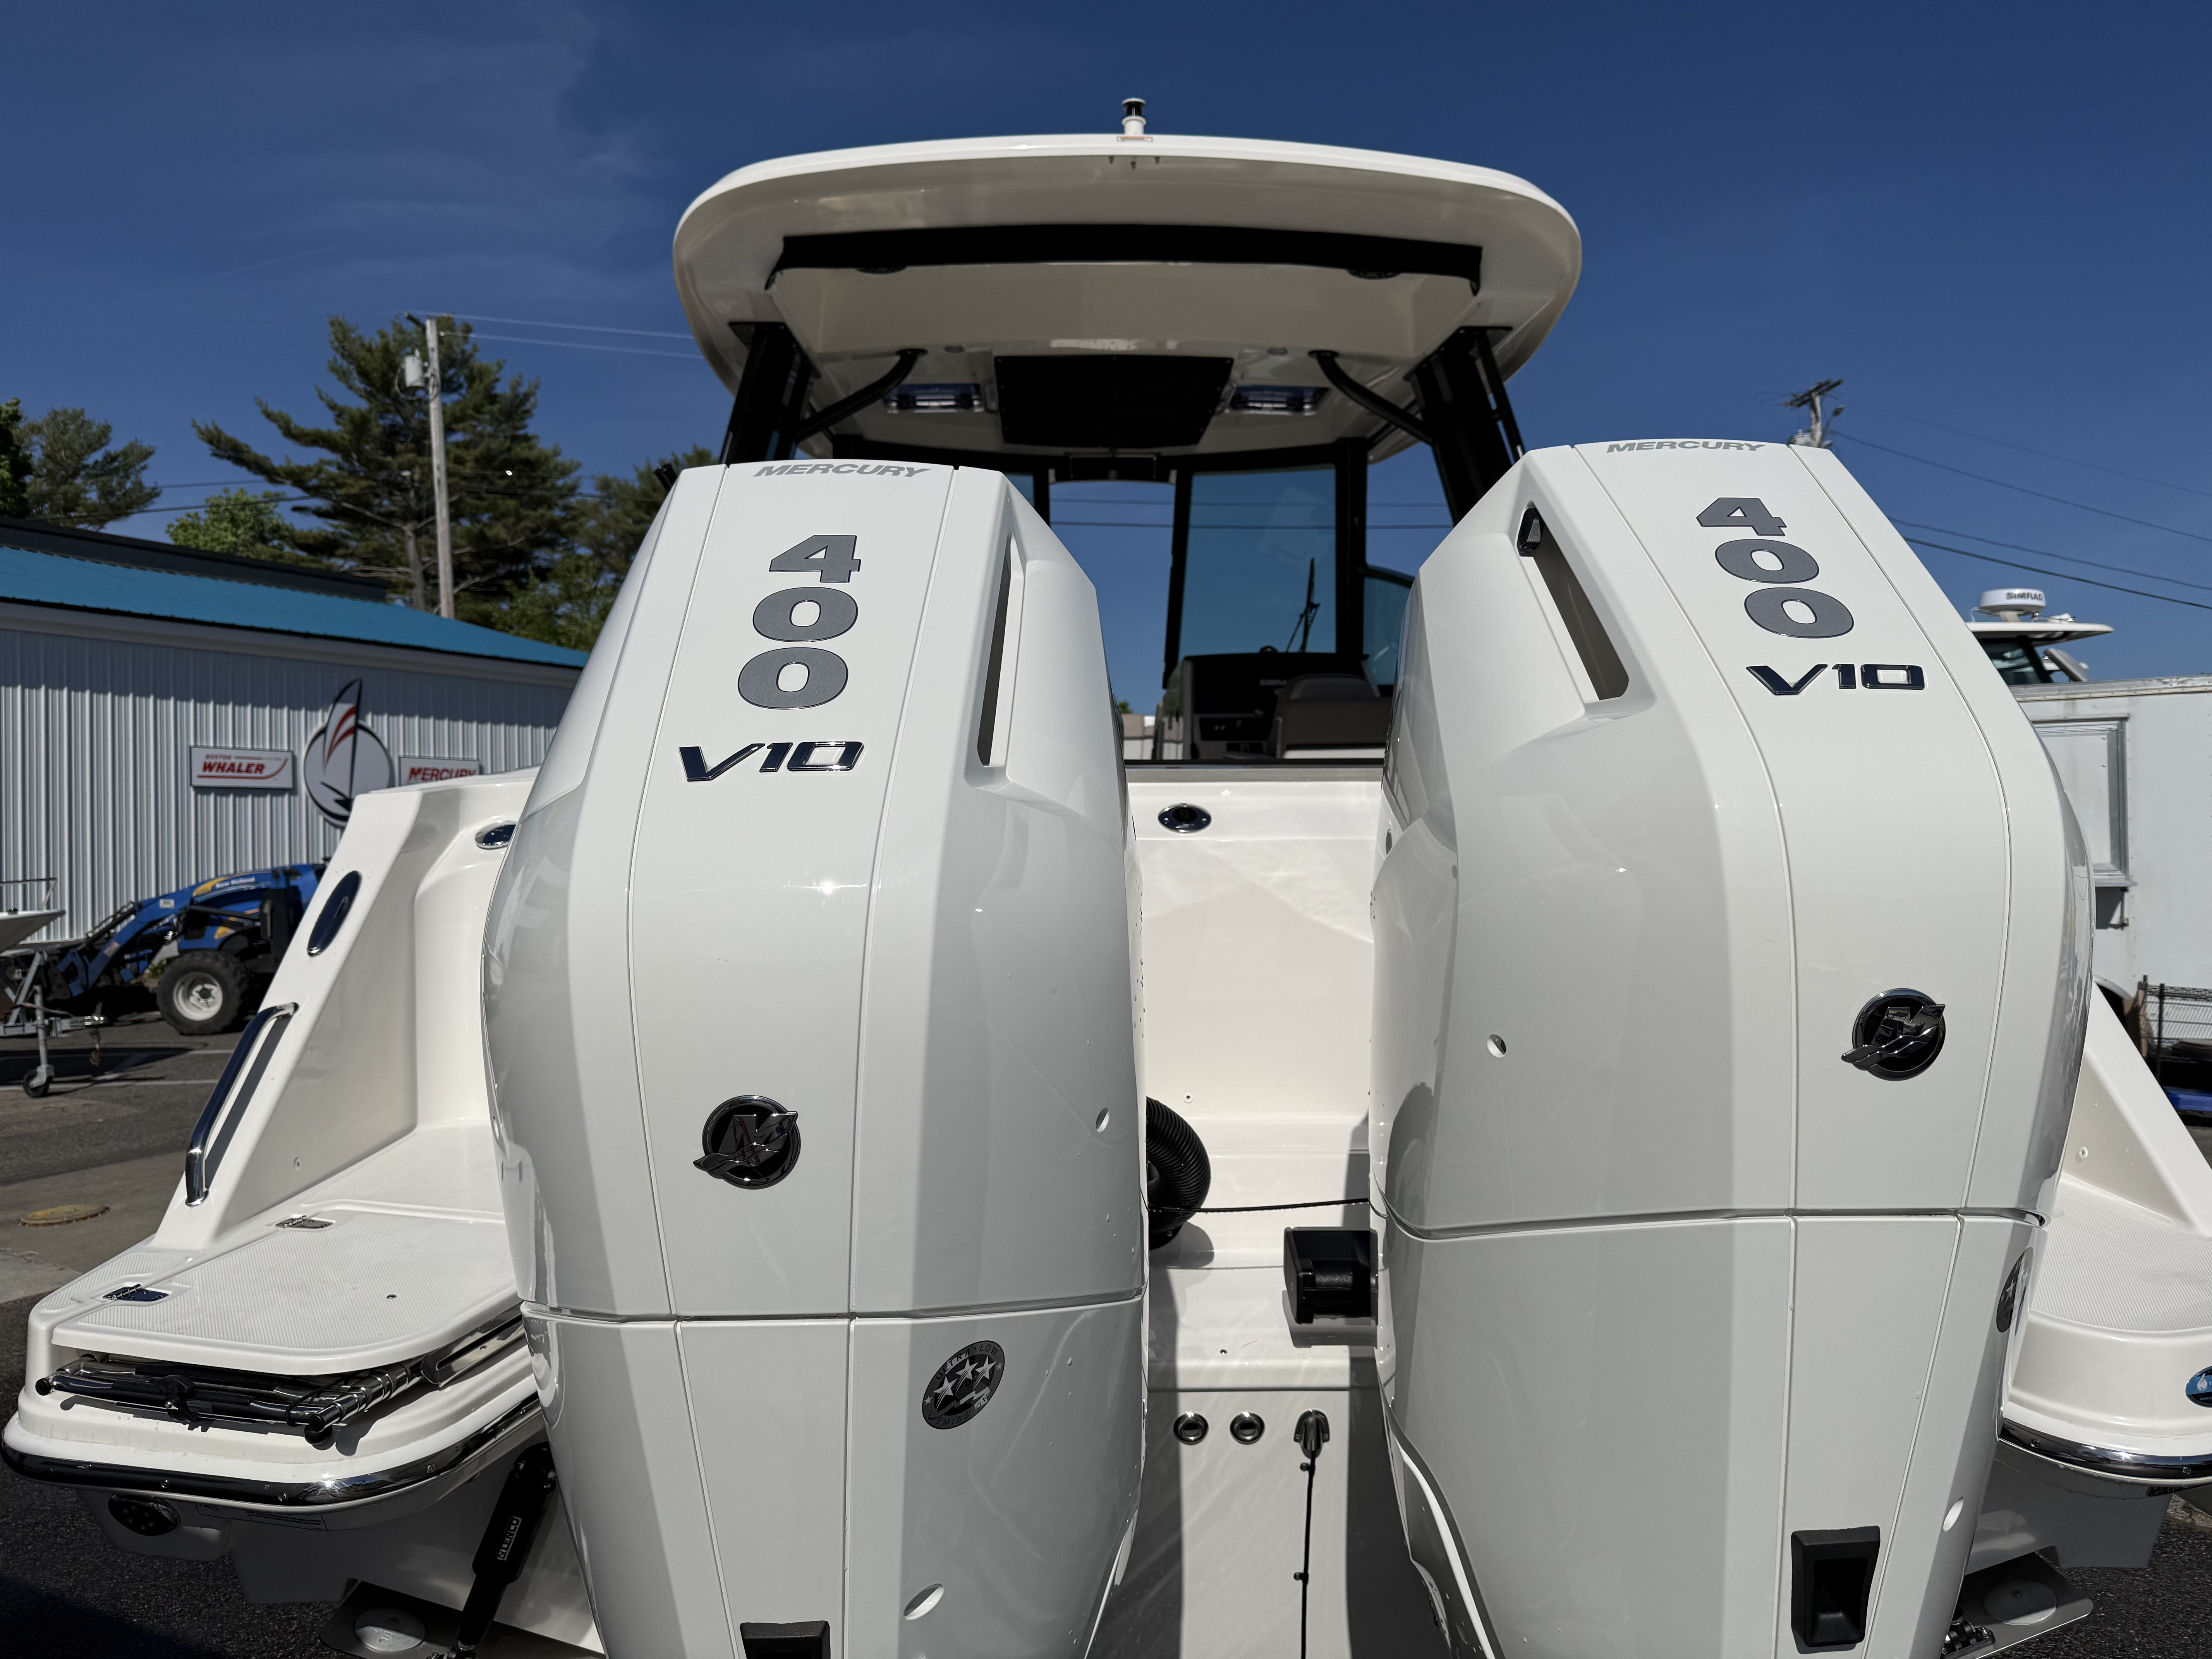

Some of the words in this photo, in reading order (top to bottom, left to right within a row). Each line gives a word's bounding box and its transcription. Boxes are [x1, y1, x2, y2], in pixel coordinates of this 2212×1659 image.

[1606, 440, 1766, 453] MERCURY
[753, 464, 931, 477] MERCURY
[1696, 497, 1854, 639] 400
[2006, 592, 2043, 600] SIMRAD
[737, 534, 862, 710] 400
[1746, 663, 1925, 696] V10
[202, 761, 265, 774] WHALER
[678, 741, 864, 782] V10
[937, 1394, 989, 1425] EMISSION
